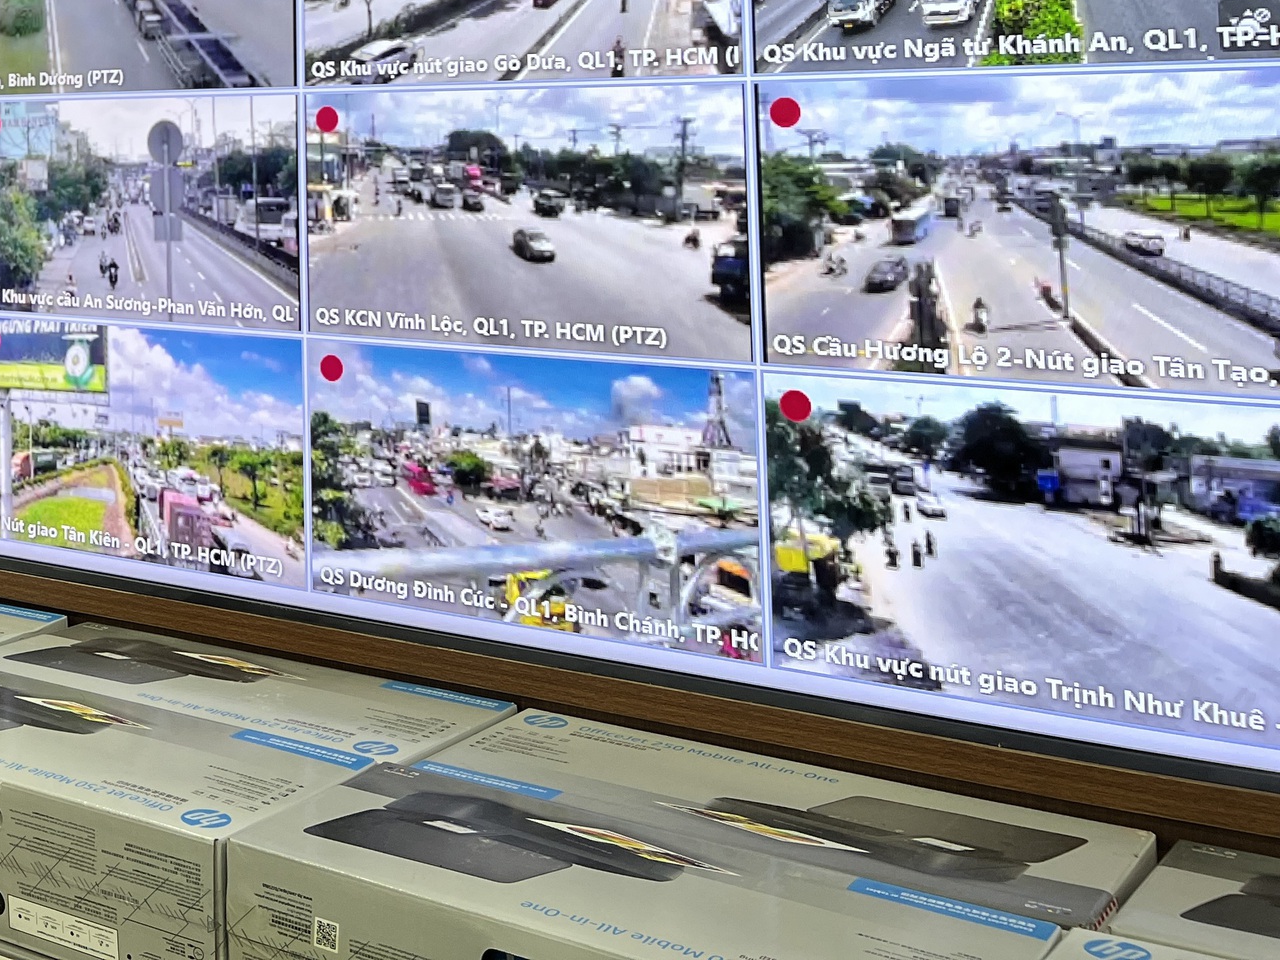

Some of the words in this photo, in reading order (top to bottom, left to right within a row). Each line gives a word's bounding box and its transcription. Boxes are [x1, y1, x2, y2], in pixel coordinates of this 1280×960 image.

[311, 62, 336, 80] QS
[340, 60, 372, 77] Khu
[377, 60, 410, 79] vực
[413, 56, 443, 74] nút
[448, 57, 489, 77] giao
[493, 53, 521, 71] Gò
[526, 52, 572, 73] Dưa,
[578, 51, 623, 72] QL1,
[628, 49, 659, 68] TP.
[666, 47, 719, 66] HCM
[763, 44, 796, 65] QS
[802, 41, 847, 62] Khu
[852, 41, 897, 65] vực
[904, 36, 956, 64] Ngã
[962, 37, 992, 58] tư
[998, 32, 1083, 56] Khánh
[1088, 33, 1135, 58] An,
[1143, 28, 1207, 54] QL1,
[8, 72, 36, 87] Bình
[39, 71, 83, 88] Dương
[87, 69, 124, 86] (PTZ)
[1, 288, 27, 305] Khu
[29, 290, 54, 310] vực
[56, 290, 80, 308] cầu
[83, 293, 103, 309] An
[106, 294, 195, 317] Sương-Phan
[198, 298, 225, 317] Văn
[230, 301, 267, 322] Hớn,
[316, 307, 340, 326] QS
[345, 308, 382, 328] KCN
[386, 311, 426, 331] Vĩnh
[431, 315, 468, 337] Lộc,
[473, 319, 516, 340] QL1,
[521, 320, 550, 339] TP.
[555, 322, 605, 342] HCM
[611, 324, 667, 349] (PTZ)
[773, 334, 806, 356] QS
[812, 335, 858, 360] Cầu
[865, 339, 950, 369] Hương
[958, 343, 988, 370] Lộ
[996, 346, 1075, 372] 2-Nút
[1081, 352, 1145, 380] giao
[1152, 355, 1205, 380] Tân
[1211, 358, 1279, 389] Tạo,
[1, 513, 25, 533] Nút
[27, 522, 58, 540] giao
[61, 524, 86, 543] Tân
[89, 529, 121, 549] Kiên
[134, 536, 166, 559] QL1,
[170, 541, 193, 560] TP.
[198, 545, 236, 568] HCM
[240, 550, 283, 578] (PTZ)
[319, 565, 345, 585] QS
[349, 572, 408, 599] Dương
[413, 578, 456, 602] Đình
[460, 585, 495, 609] Cúc
[514, 597, 558, 622] QL1,
[564, 603, 609, 628] Bình
[614, 612, 685, 642] Chánh,
[691, 622, 723, 645] TP.
[783, 637, 817, 661] QS
[823, 643, 869, 669] Khu
[877, 655, 924, 683] vực
[929, 658, 972, 685] nút
[979, 669, 1038, 697] giao
[1045, 677, 1115, 710] Trịnh
[1124, 690, 1186, 718] Như
[1192, 700, 1266, 732] Khuê
[525, 713, 568, 728] hp
[578, 726, 648, 745] OfficeJet
[651, 741, 685, 753] 250
[687, 747, 744, 765] Mobile
[747, 760, 840, 785] All-in-One
[28, 766, 77, 784] Mobile
[75, 780, 108, 793] 250
[106, 788, 174, 812] OfficeJet
[183, 809, 230, 828] hp
